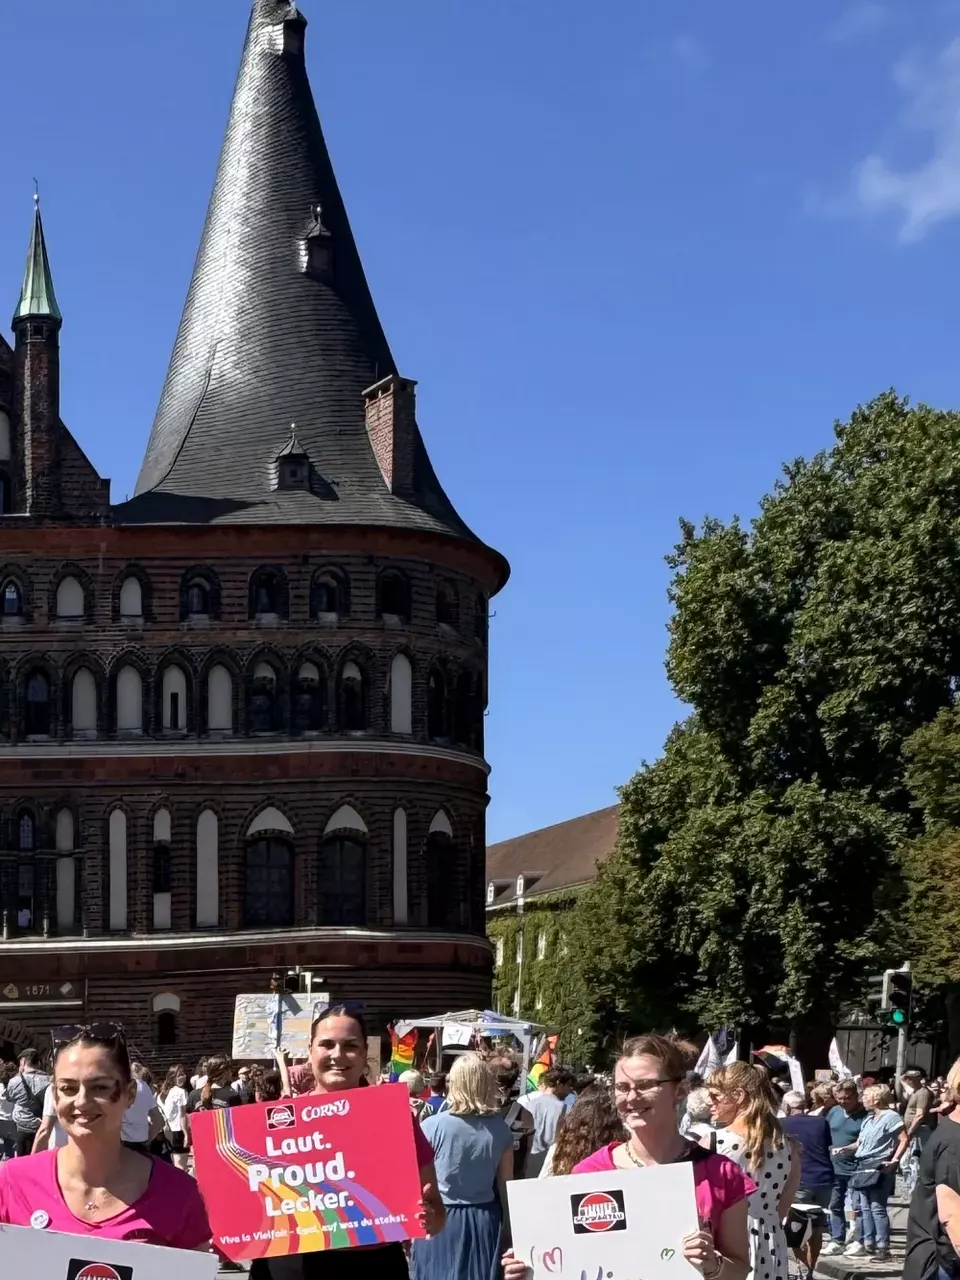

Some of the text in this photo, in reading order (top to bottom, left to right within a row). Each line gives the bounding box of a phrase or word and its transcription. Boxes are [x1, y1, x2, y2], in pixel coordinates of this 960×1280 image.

[301, 1099, 350, 1122] CORNY
[265, 1131, 332, 1157] Laut.
[247, 1151, 356, 1192] Proud.
[265, 1190, 355, 1217] Lecker.
[219, 1235, 241, 1245] Viva
[339, 1220, 359, 1230] was
[360, 1217, 373, 1227] du
